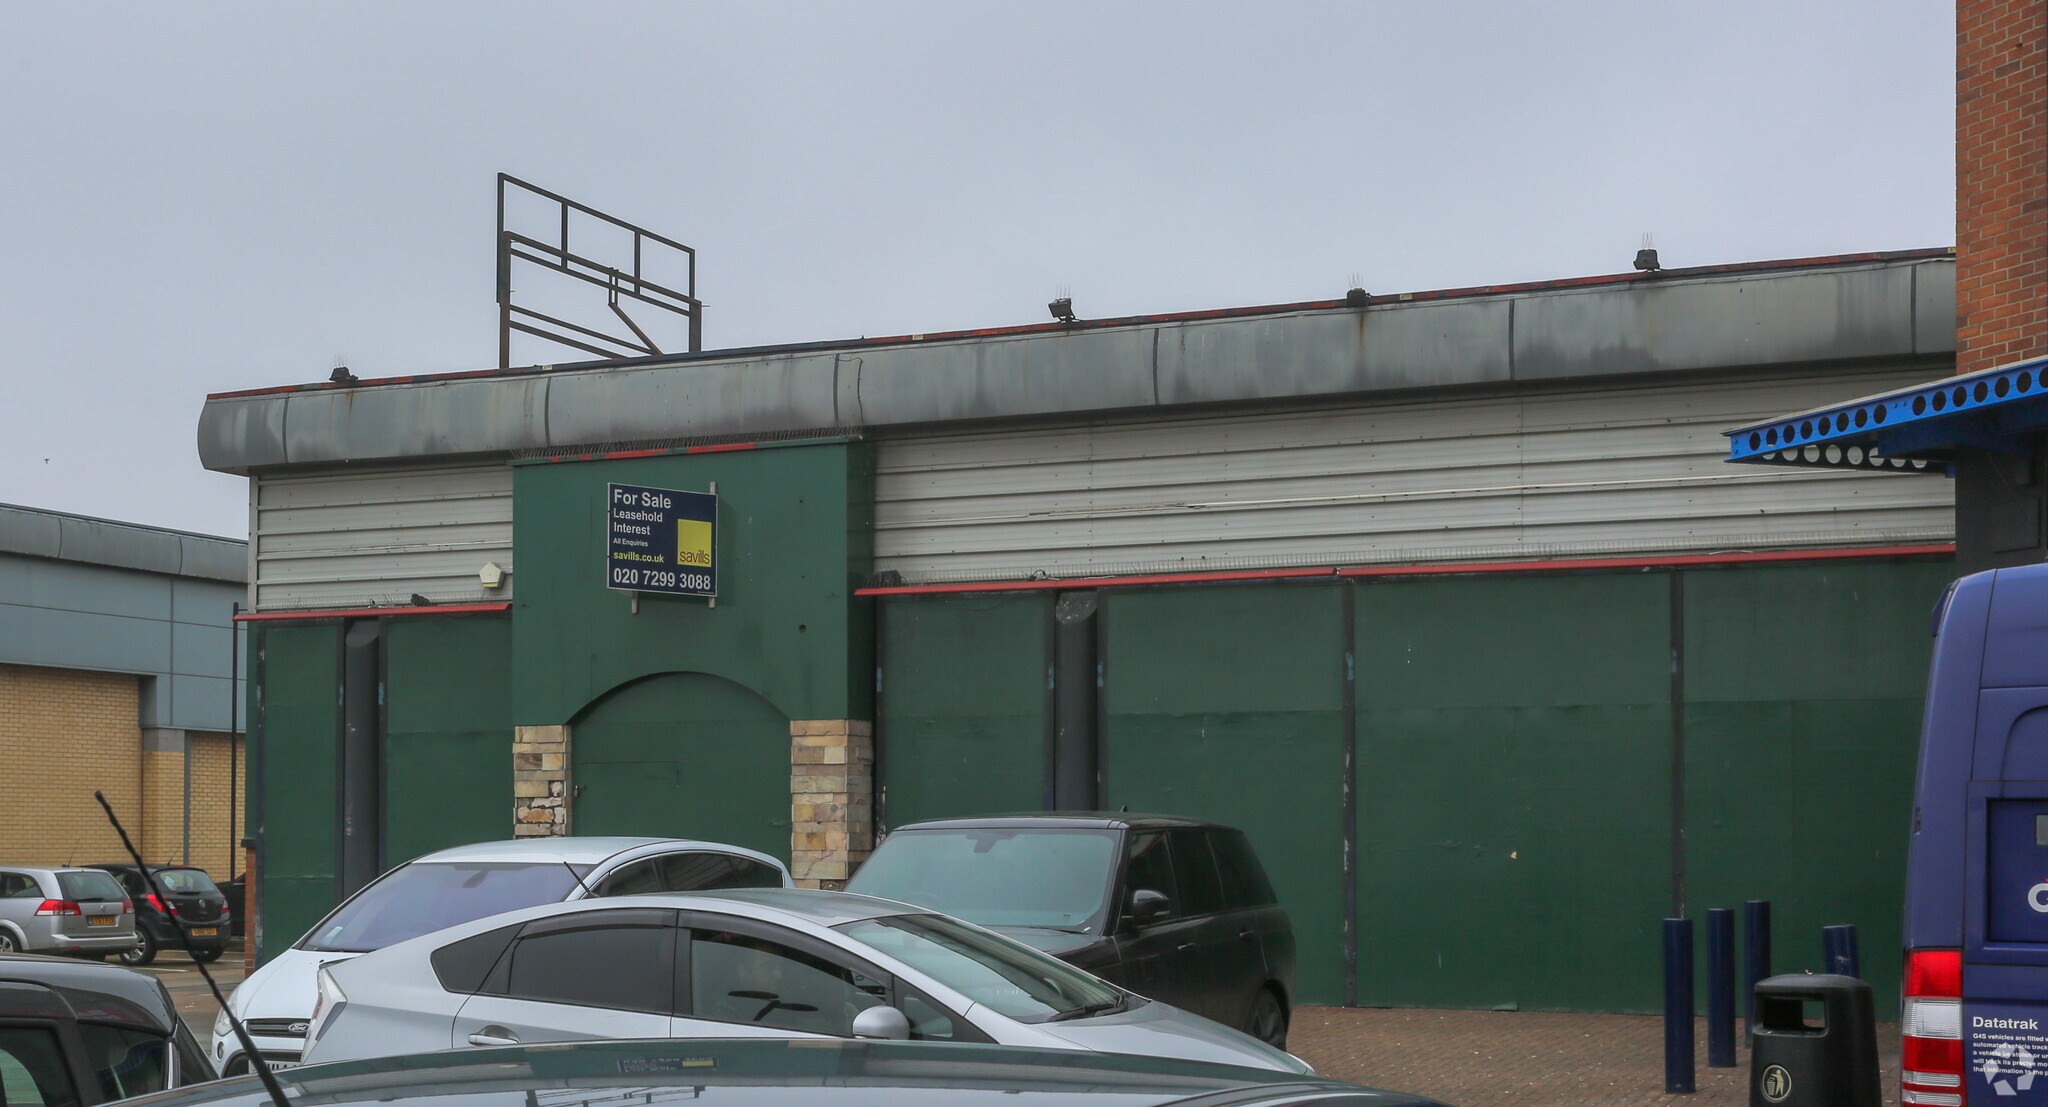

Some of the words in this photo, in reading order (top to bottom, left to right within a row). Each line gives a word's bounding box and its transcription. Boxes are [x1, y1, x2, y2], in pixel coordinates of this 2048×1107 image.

[614, 489, 638, 505] For
[642, 492, 671, 508] Sale
[614, 508, 663, 522] Leasehold
[614, 522, 650, 535] Interest
[622, 538, 648, 547] Enquiries
[614, 552, 664, 563] savills.co.uk
[680, 550, 710, 564] savills
[614, 568, 638, 584] 020
[643, 570, 676, 587] 7299
[680, 574, 710, 590] 3088
[1972, 1016, 2038, 1030] Datatrak
